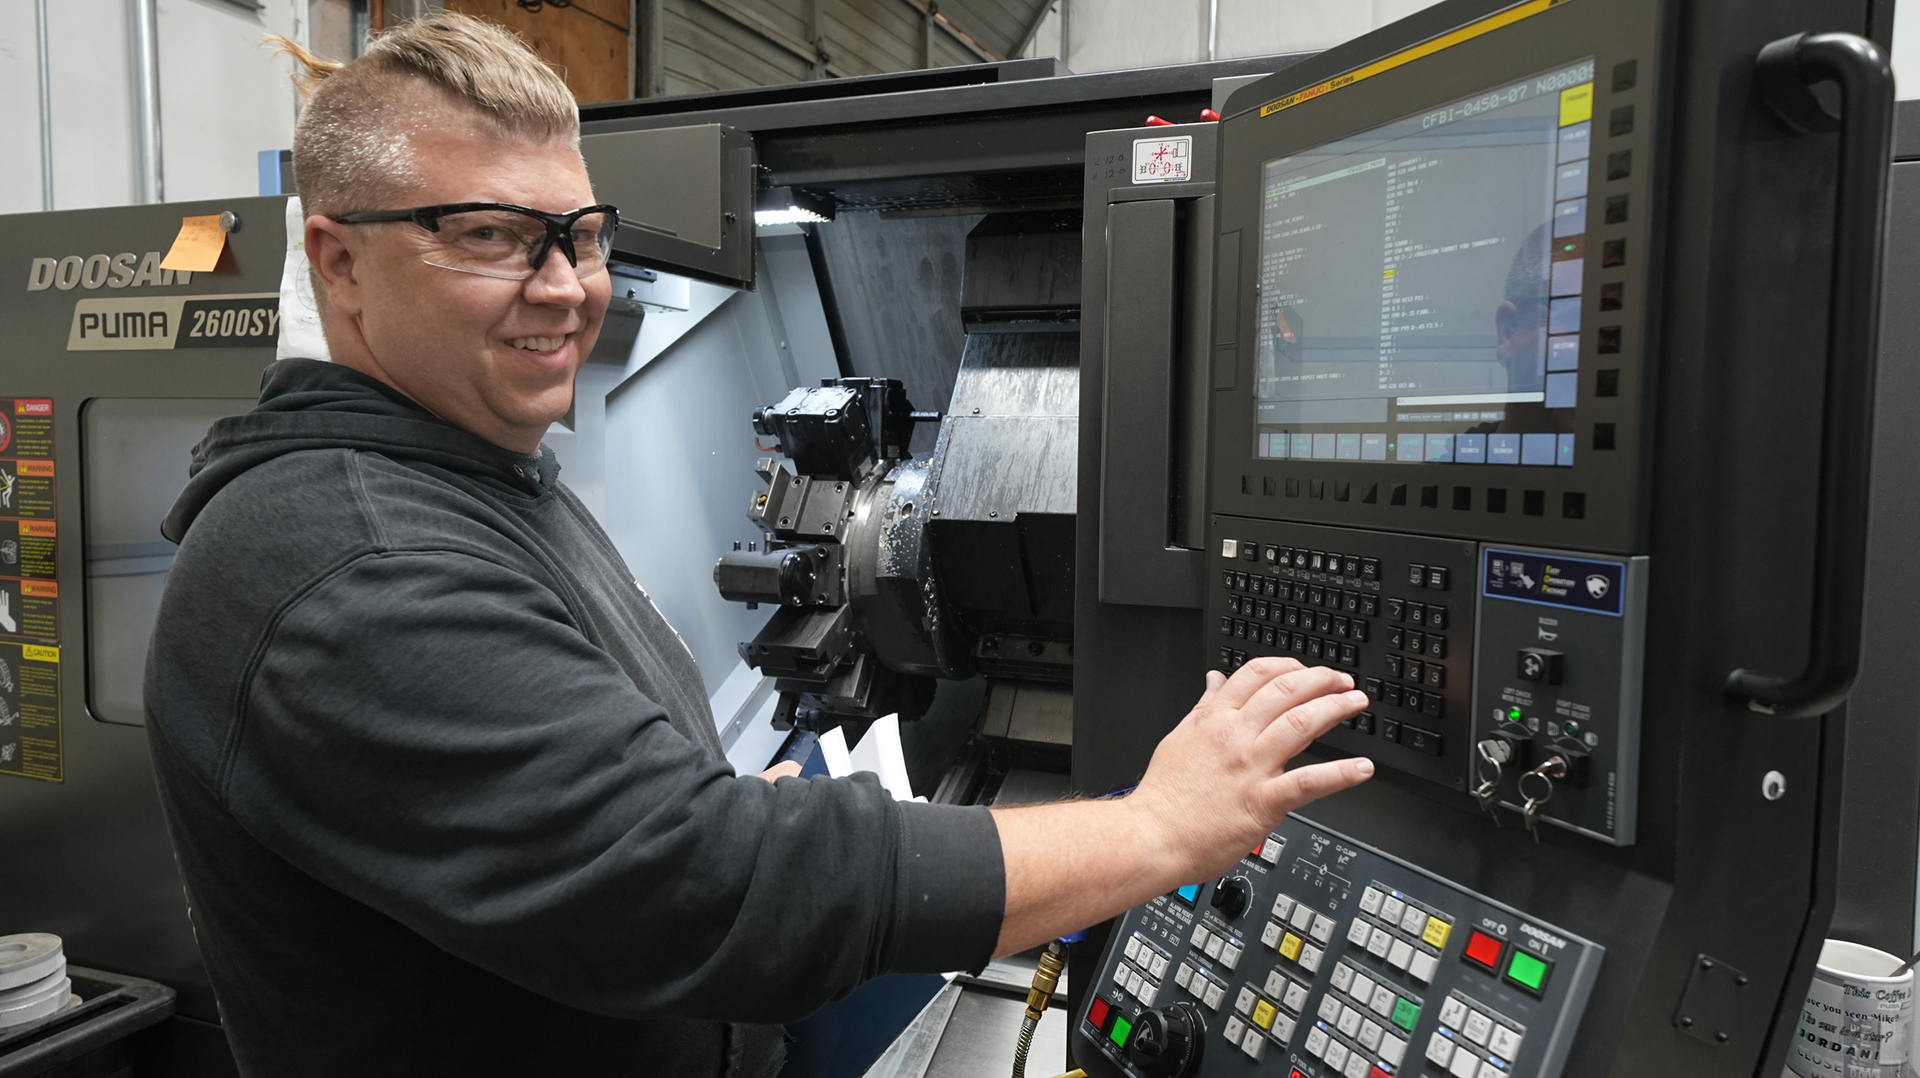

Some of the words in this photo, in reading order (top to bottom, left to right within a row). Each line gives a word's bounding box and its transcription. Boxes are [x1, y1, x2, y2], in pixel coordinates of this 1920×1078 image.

[1266, 96, 1295, 114] DOOSAN
[1300, 86, 1325, 102] FANUC
[1330, 75, 1354, 90] Series
[1422, 85, 1528, 129] CFBI-0450-07
[79, 311, 168, 339] PUMA
[190, 308, 280, 338] 2600SY
[26, 404, 50, 412] DANGER
[26, 464, 52, 473] WARNING
[29, 525, 54, 534] WARNING
[1347, 562, 1356, 571] S1
[1364, 564, 1374, 574] S2
[31, 585, 56, 594] WARNING
[1394, 606, 1400, 616] 7
[1413, 610, 1420, 620] 8
[1434, 614, 1442, 624] 9
[1392, 635, 1399, 644] 4
[1412, 638, 1419, 649] 5
[32, 649, 57, 658] CAUTION
[1433, 642, 1440, 654] 6
[1410, 666, 1418, 678] 2
[1432, 672, 1438, 682] 3
[1314, 880, 1322, 888] C1
[1169, 902, 1182, 913] ALARM
[1181, 909, 1194, 919] RESET
[1178, 912, 1192, 925] RELEASE
[1482, 917, 1497, 930] OFF
[1519, 922, 1568, 950] DOOSAN
[1528, 938, 1541, 950] ON
[1844, 984, 1872, 999] This
[1806, 996, 1821, 1008] ave
[1823, 1004, 1842, 1016] you
[1845, 1010, 1868, 1020] seen
[1797, 1026, 1880, 1060] JORDAN!
[1797, 1045, 1844, 1074] CLOSE
